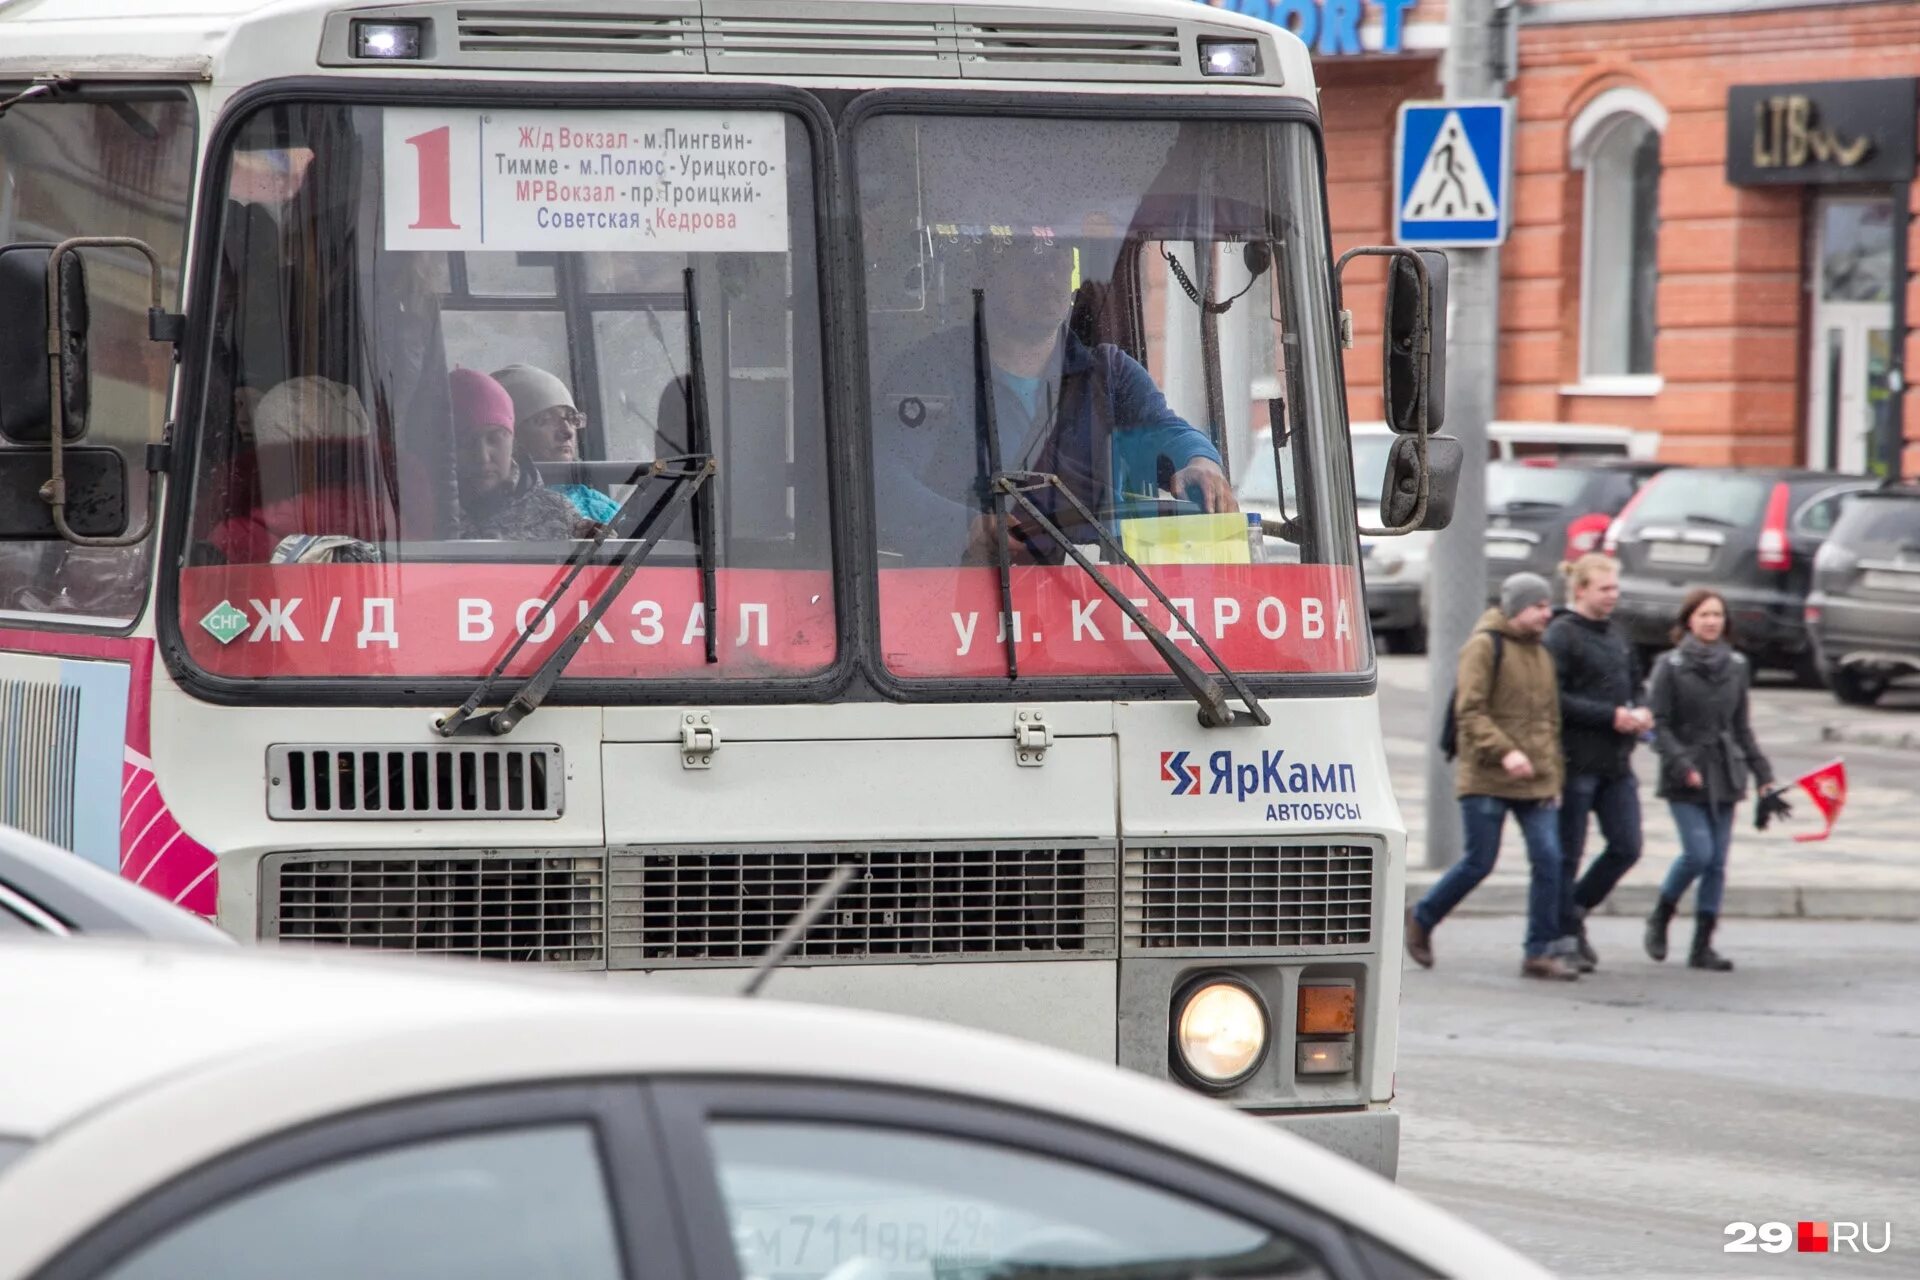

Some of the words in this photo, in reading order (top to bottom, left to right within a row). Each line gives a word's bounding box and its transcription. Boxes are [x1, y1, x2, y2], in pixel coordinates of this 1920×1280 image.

[518, 126, 554, 152] Ж/д
[405, 126, 461, 230] 1
[656, 208, 737, 233] Кедрова
[210, 614, 241, 630] СНГ
[249, 597, 399, 649] Ж/Д
[458, 598, 769, 647] ВОКЗАЛ
[951, 611, 1041, 655] ул.
[1071, 597, 1354, 647] КЕДРОВА
[1209, 750, 1357, 802] ЯрКамп
[1266, 803, 1362, 821] АВТОБУСЫ
